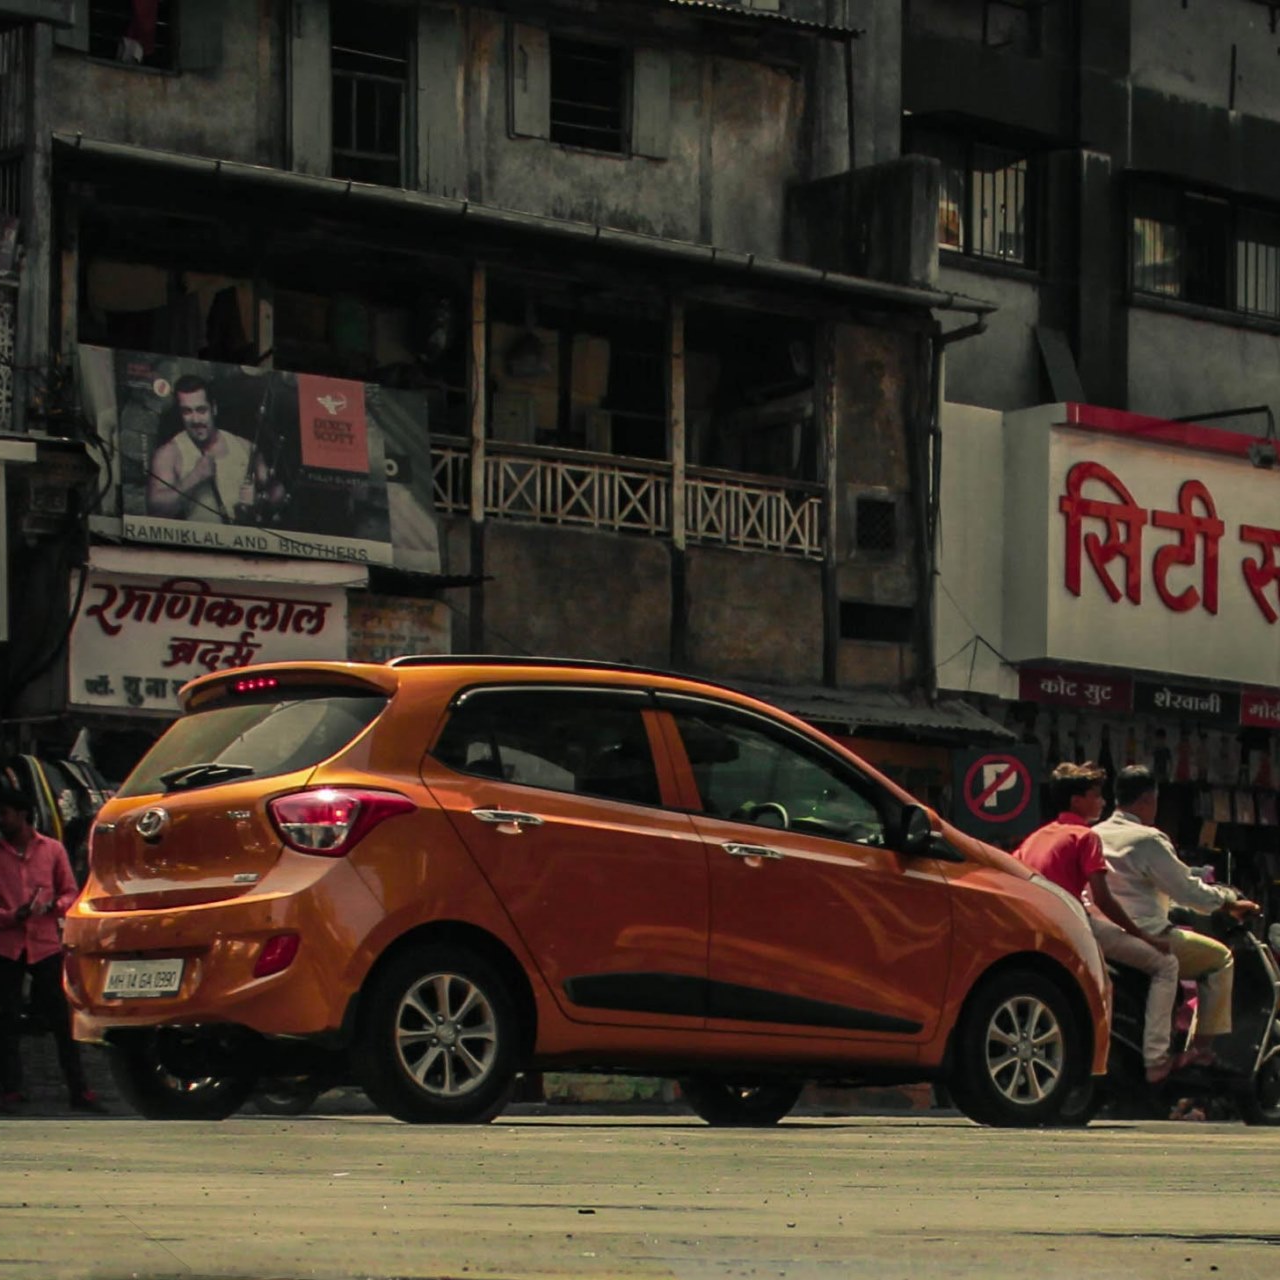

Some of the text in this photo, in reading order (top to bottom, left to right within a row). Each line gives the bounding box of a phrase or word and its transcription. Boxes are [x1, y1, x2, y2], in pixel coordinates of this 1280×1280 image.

[124, 523, 369, 562] RAMNIKLAL AND BROTHERS
[1059, 461, 1224, 616] सिटी
[86, 578, 332, 636] रमणिकलाल
[1040, 675, 1113, 705] कोट सुट
[1154, 688, 1220, 713] शेरवानी
